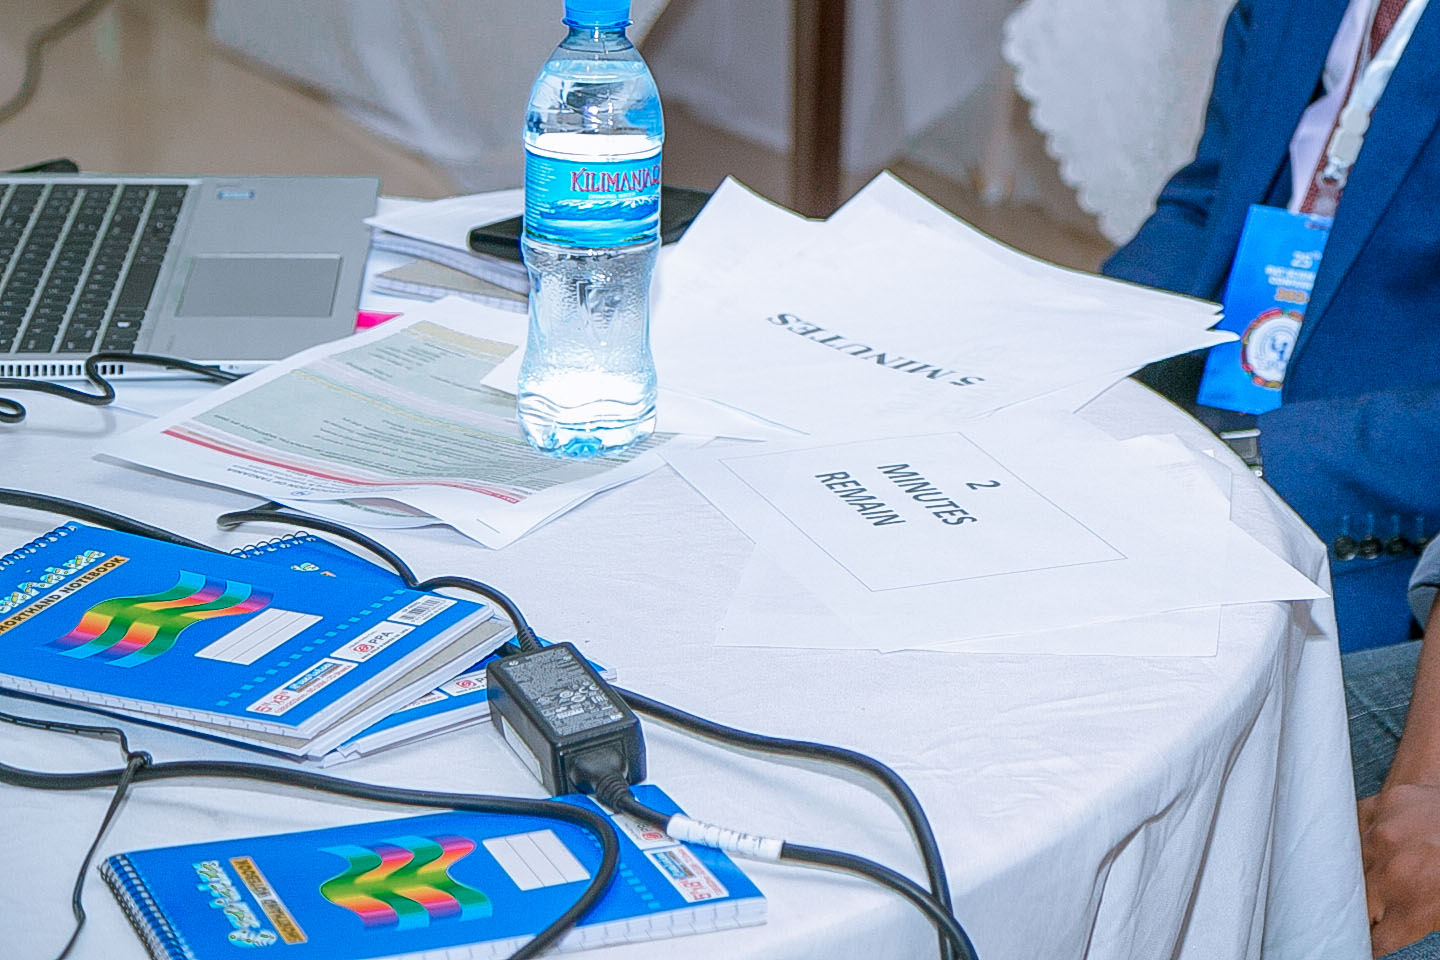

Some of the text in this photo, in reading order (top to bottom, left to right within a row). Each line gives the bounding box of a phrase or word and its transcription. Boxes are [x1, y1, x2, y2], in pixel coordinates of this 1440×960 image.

[766, 311, 985, 387] 5 MINUTES
[815, 471, 907, 527] REMAIN
[877, 463, 978, 526] MINUTES
[965, 479, 1001, 491] 2
[0, 593, 62, 634] HORTHAND
[60, 557, 126, 594] NOTEBOOK
[369, 630, 393, 645] PPA
